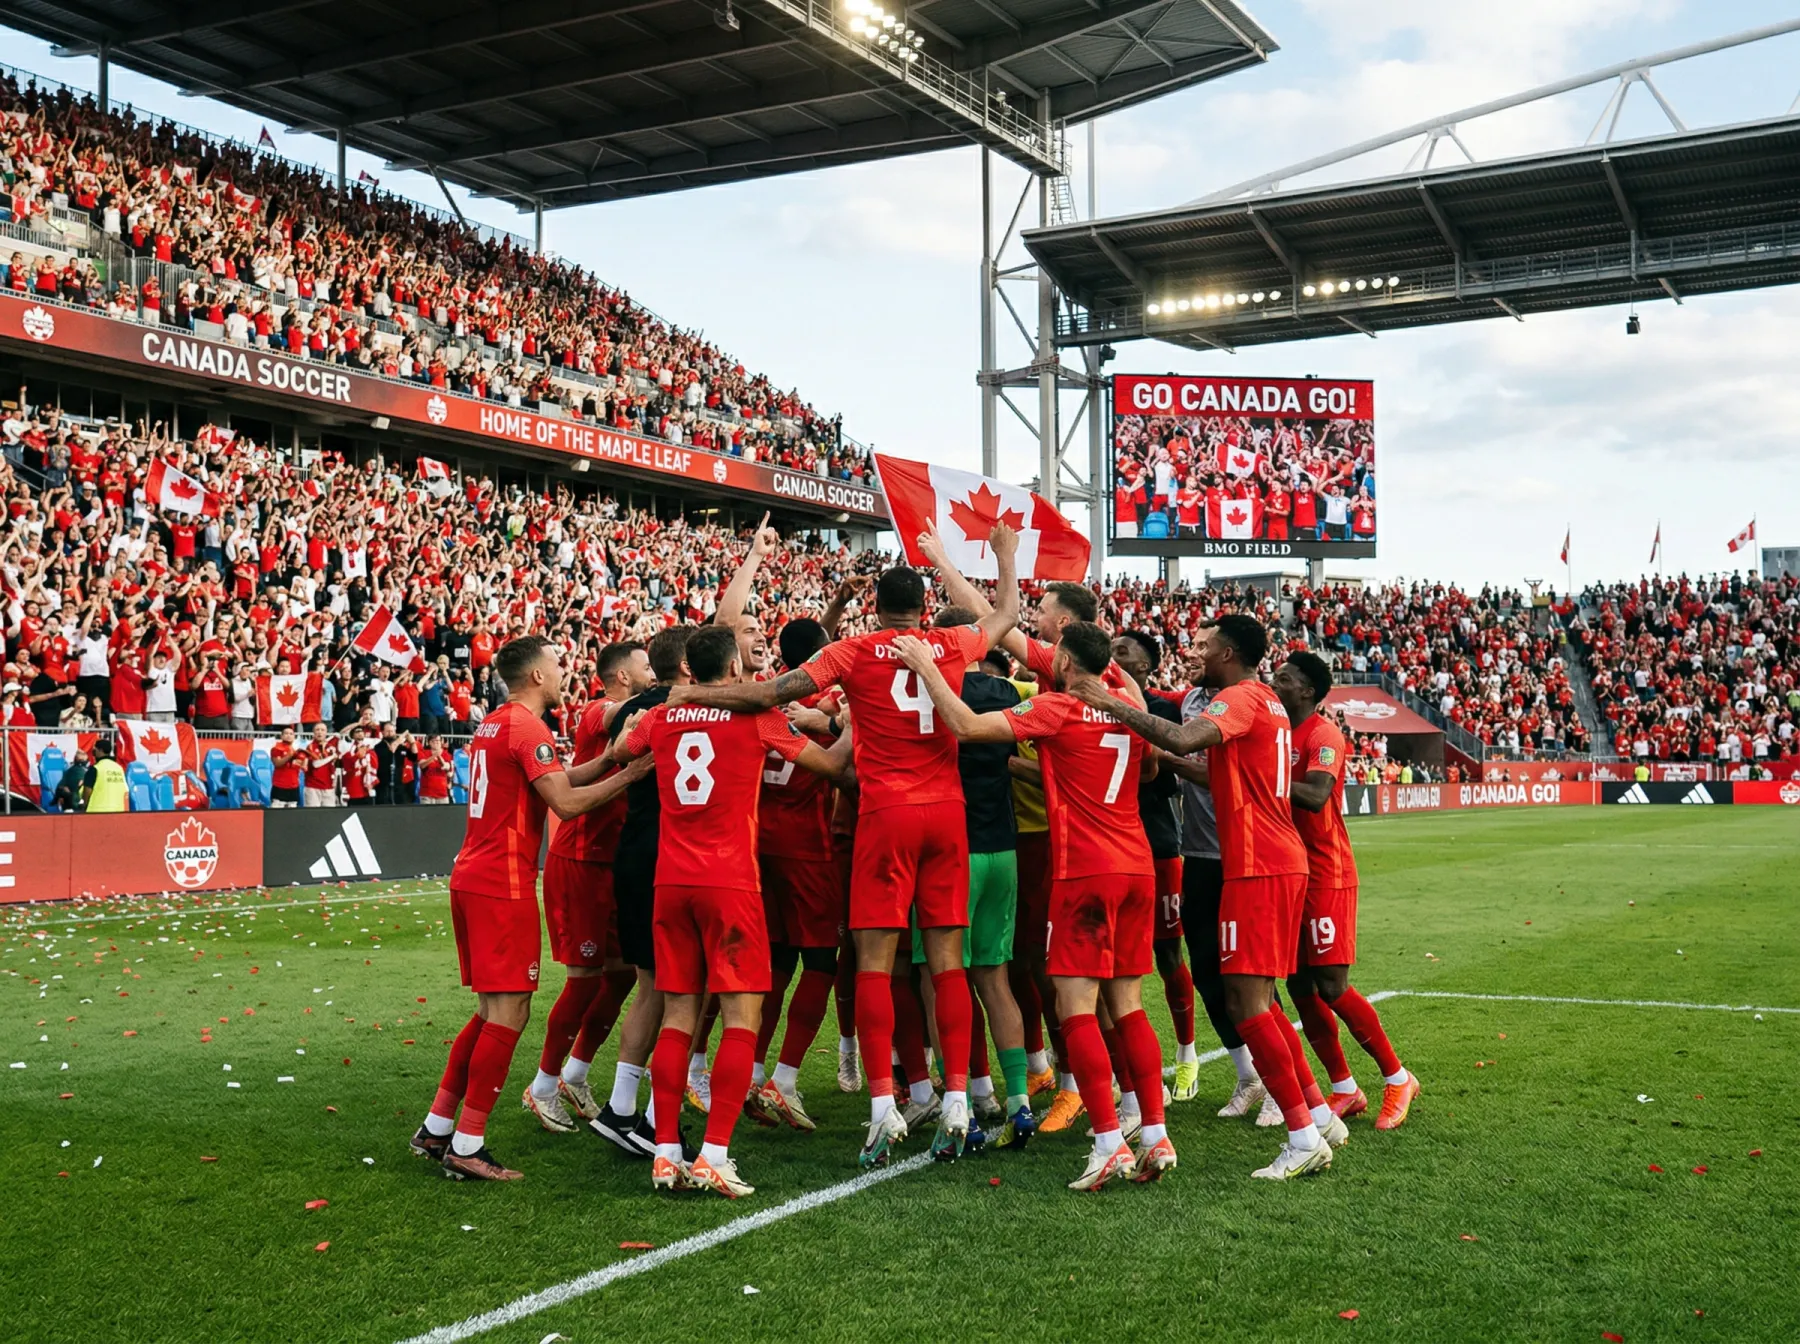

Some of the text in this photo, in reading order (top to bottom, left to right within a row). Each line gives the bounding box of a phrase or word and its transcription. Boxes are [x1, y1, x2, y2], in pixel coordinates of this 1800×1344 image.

[142, 332, 351, 403] CANADA SOCCER
[1132, 382, 1356, 414] GO CANADA GO!
[480, 407, 691, 473] HOME OF THE MAPLE LEAF
[773, 472, 874, 513] CANADA SOCCER
[1204, 542, 1292, 555] BMO FIELD
[666, 707, 732, 723] CANADA
[890, 668, 935, 735] 4
[674, 731, 716, 805] 8
[1098, 732, 1131, 804] 7
[1275, 727, 1292, 799] 11
[1460, 783, 1561, 806] GO CANADA GO!
[166, 848, 216, 861] CANADA
[1220, 920, 1237, 952] 11
[1309, 917, 1336, 945] 19
